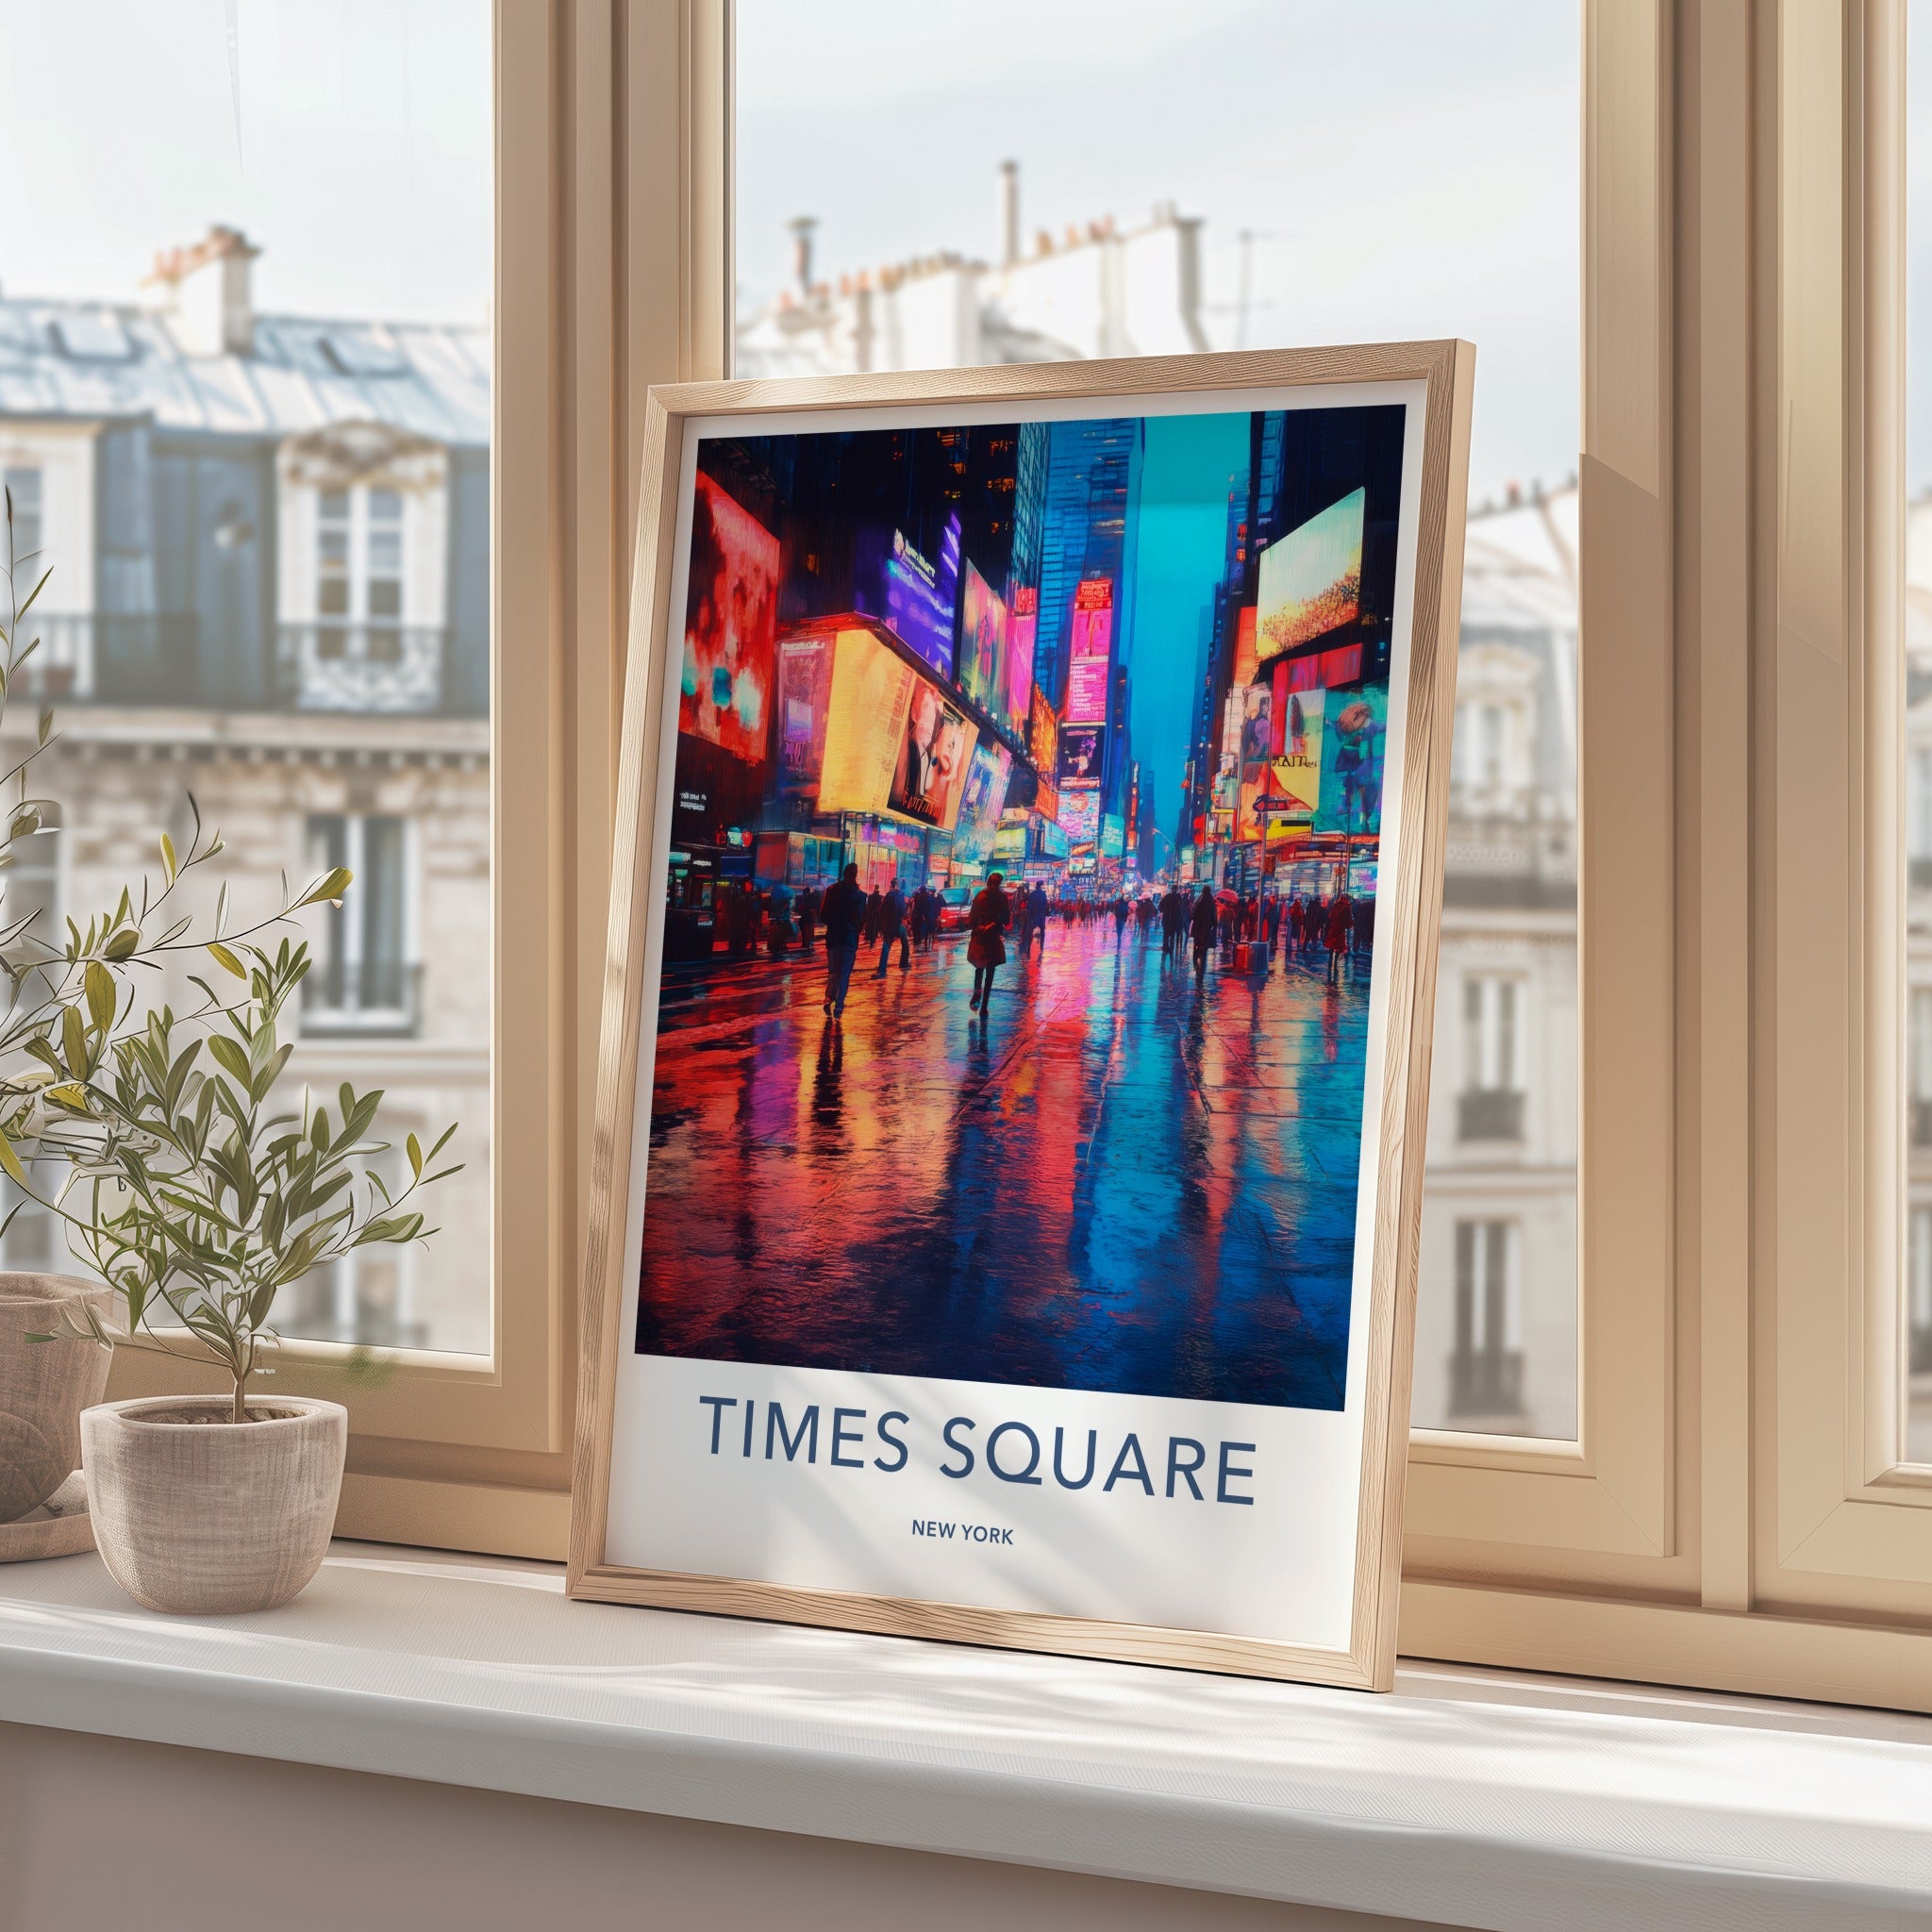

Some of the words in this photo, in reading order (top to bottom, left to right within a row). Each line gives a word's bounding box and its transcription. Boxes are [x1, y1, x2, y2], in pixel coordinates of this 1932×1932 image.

[698, 1395, 910, 1473] TIMES
[939, 1416, 1257, 1506] SQUARE
[911, 1519, 957, 1540] NEW
[961, 1524, 1014, 1545] YORK
